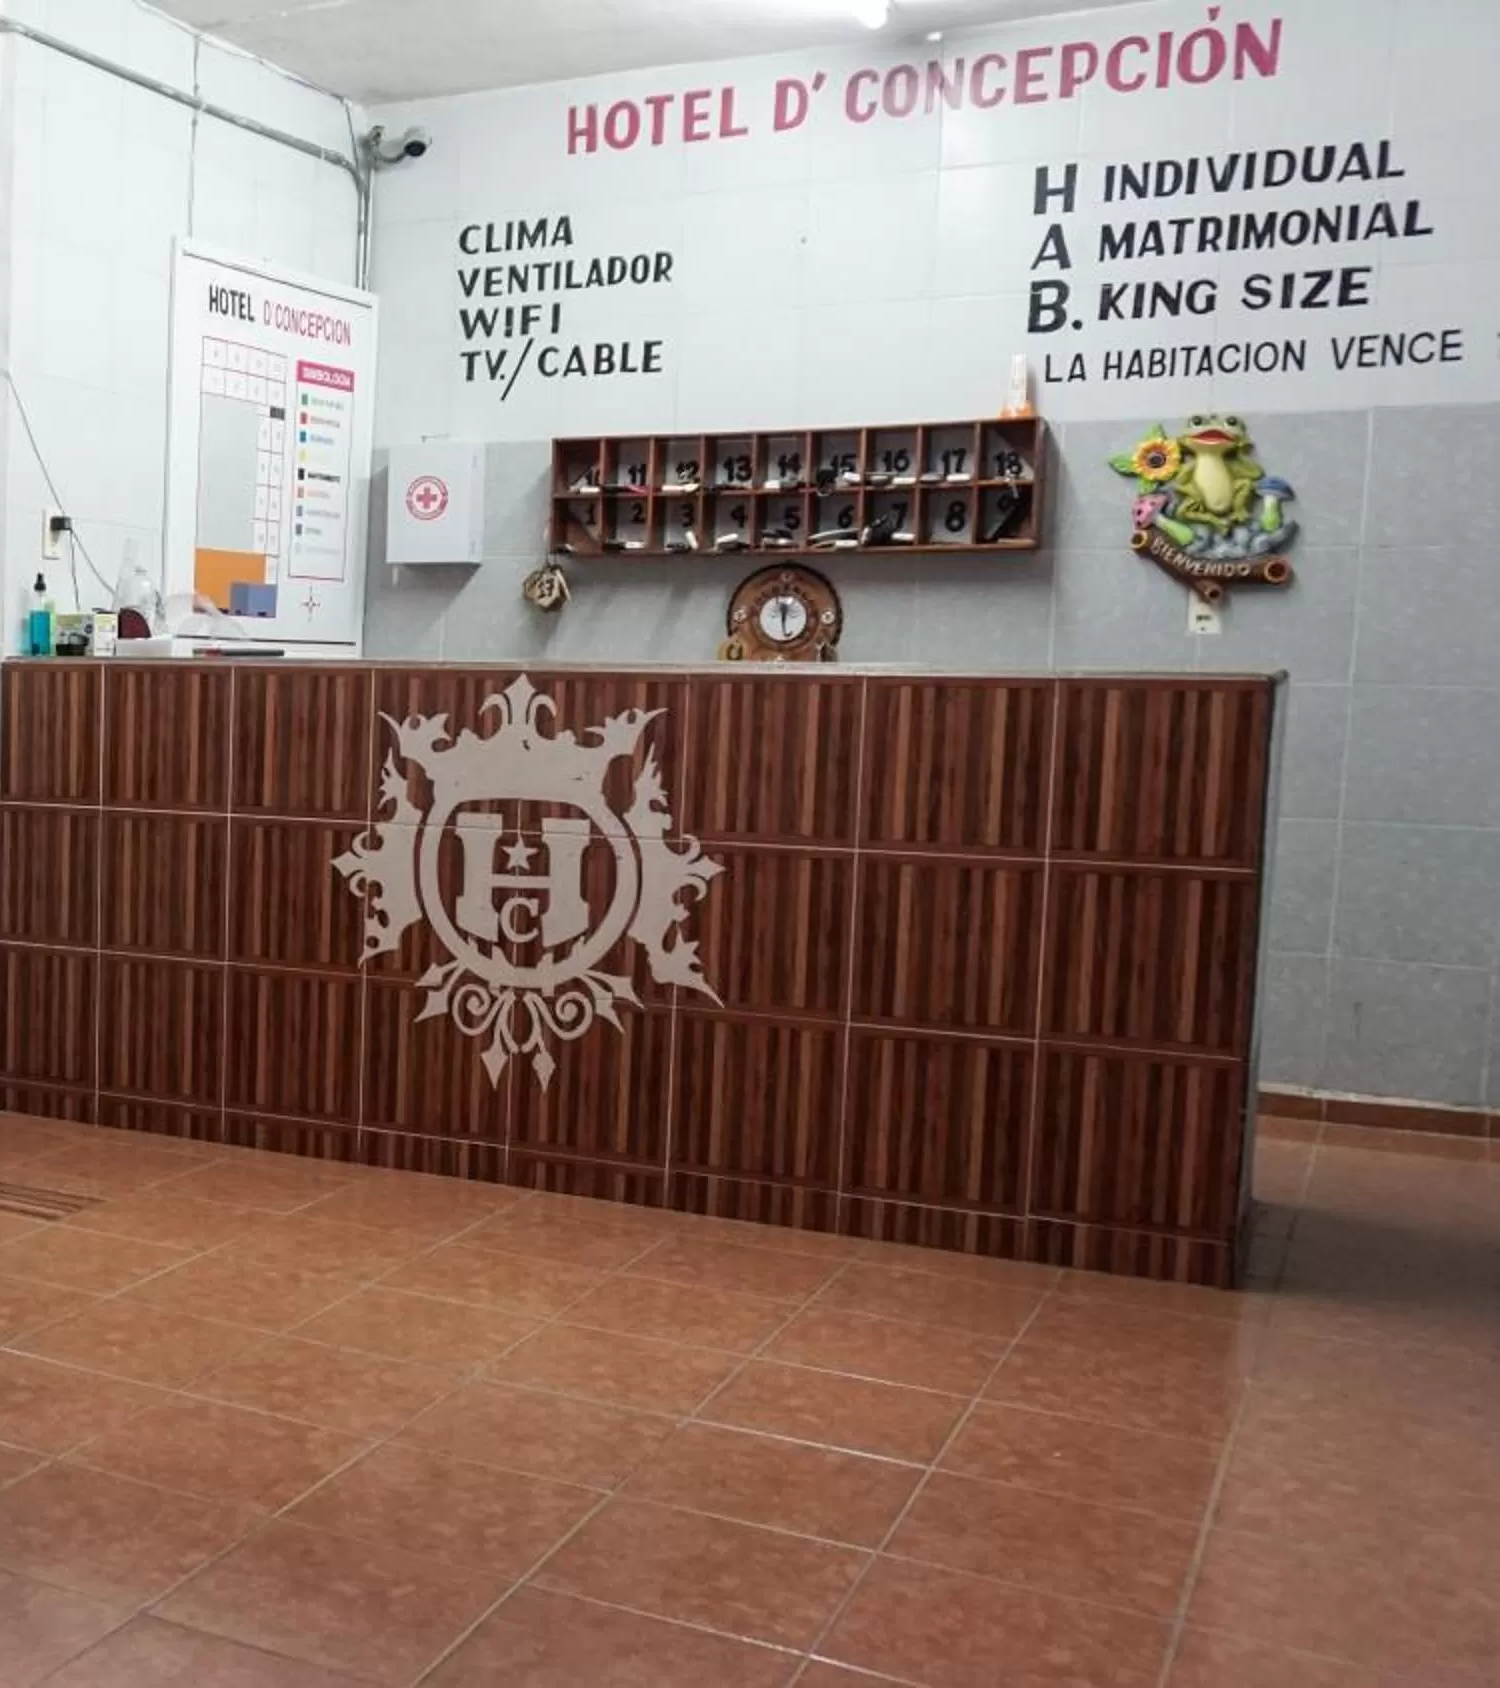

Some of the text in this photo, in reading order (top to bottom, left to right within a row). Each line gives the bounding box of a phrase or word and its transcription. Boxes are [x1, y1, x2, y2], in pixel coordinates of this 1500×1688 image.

[567, 86, 749, 155] HOTEL
[845, 6, 1283, 123] CONCEPCIÓN
[1103, 139, 1405, 203] INDIVIDUAL
[458, 215, 574, 255] CLIMA
[1098, 200, 1435, 262] MATRIMONIAL
[457, 251, 674, 298] VENTILADOR
[209, 284, 255, 322] HOTEL
[1097, 267, 1373, 321] KING SIZE
[1044, 353, 1087, 383] LA
[1102, 339, 1306, 381] HABITACION
[1330, 329, 1464, 370] VENCE
[627, 464, 647, 485] 11
[723, 455, 751, 481] 13
[831, 452, 857, 475] 15
[883, 448, 910, 474] 16
[941, 448, 966, 475] 17
[994, 450, 1022, 476] 18
[586, 503, 596, 525] 1
[630, 503, 646, 523] 2
[680, 503, 695, 527] 3
[731, 504, 748, 528] 4
[784, 506, 800, 530] 5
[837, 504, 854, 528] 6
[891, 502, 908, 530] 7
[945, 501, 966, 532] 8
[1150, 536, 1251, 577] BIENVENIDO
